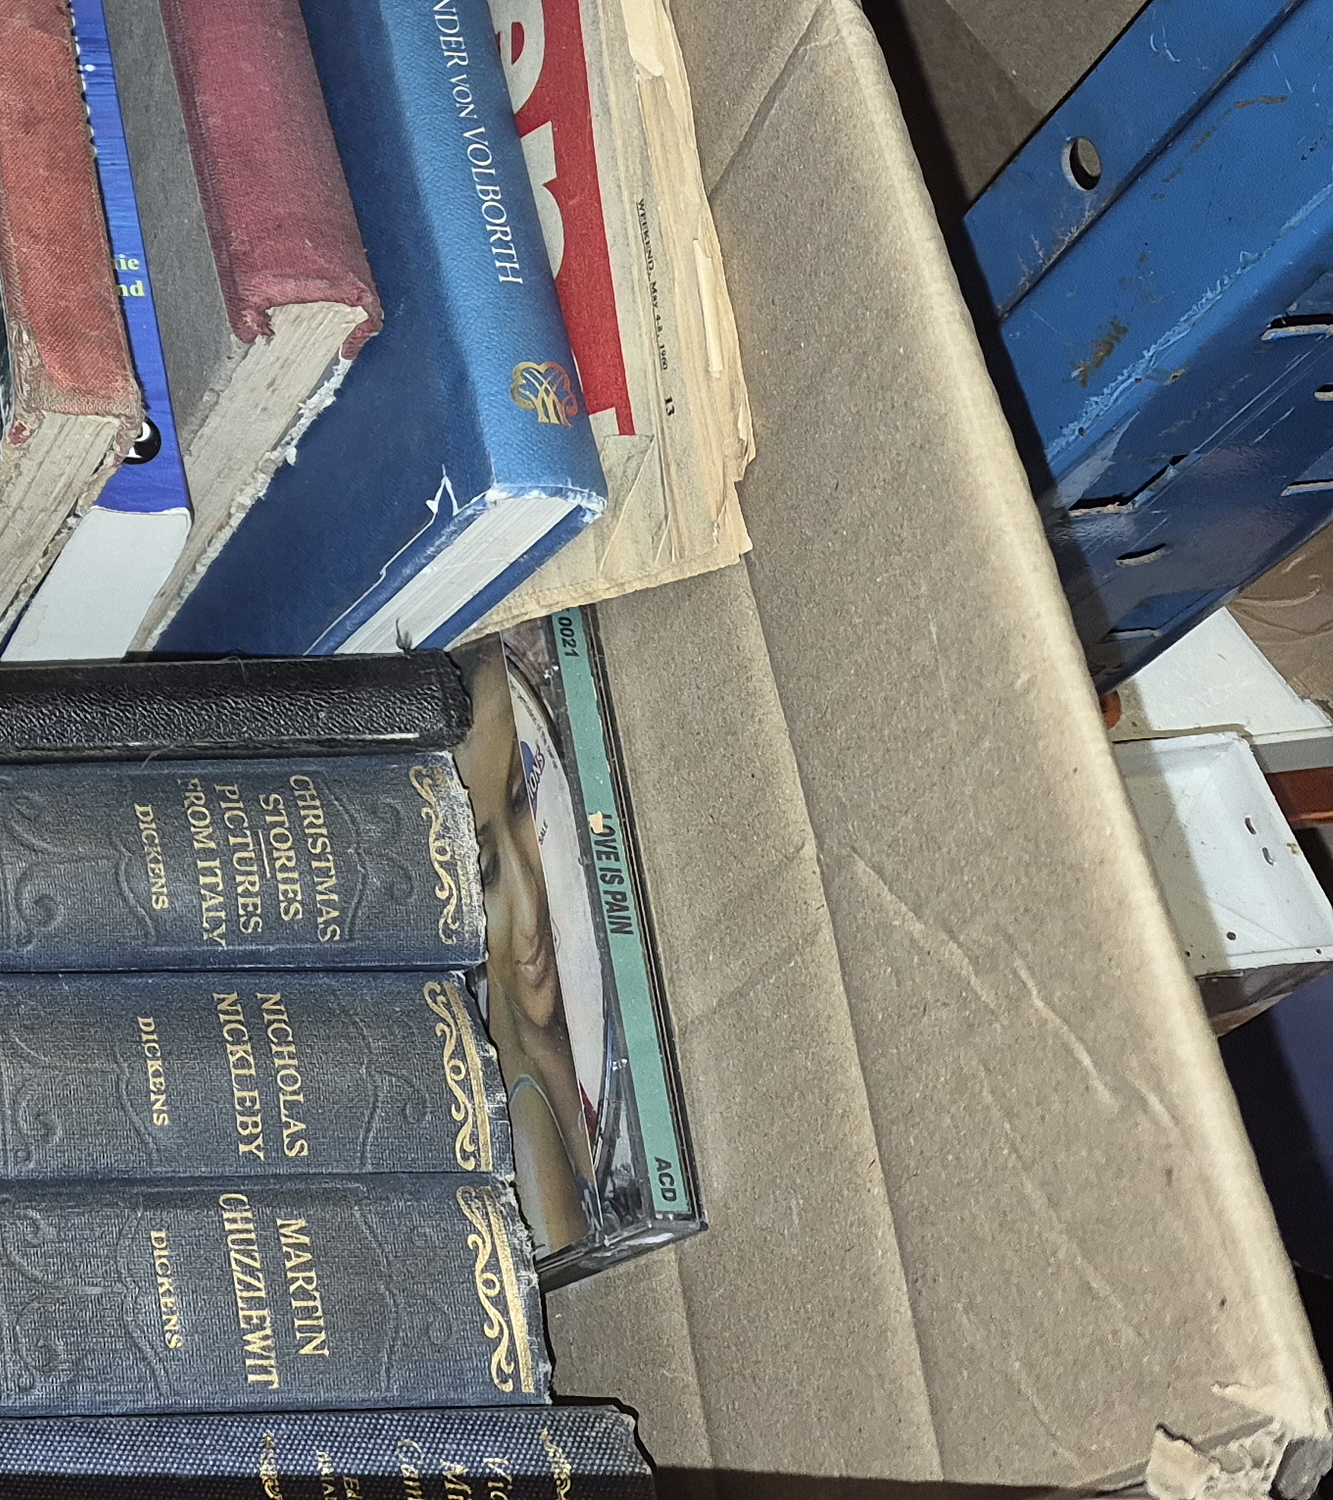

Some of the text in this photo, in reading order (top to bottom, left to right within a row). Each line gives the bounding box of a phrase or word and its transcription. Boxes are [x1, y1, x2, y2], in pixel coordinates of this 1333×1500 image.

[452, 71, 477, 120] VON
[462, 125, 524, 286] VOLBORTH
[649, 280, 659, 310] May
[665, 396, 676, 417] 13
[133, 804, 170, 911] DICKENS
[195, 861, 228, 947] ITALY
[214, 781, 264, 936] PICTURES
[257, 792, 304, 921] STORIES
[288, 772, 340, 943] CHRISTMAS
[599, 869, 624, 887] IS
[604, 887, 636, 937] PAIN
[137, 1015, 170, 1127] DICKENS
[212, 990, 266, 1162] NICKLEBY
[257, 990, 311, 1160] NICHOLAS
[653, 1155, 679, 1205] ACD
[150, 1229, 184, 1351] DICKENS
[217, 1193, 281, 1391] CHUZZLEWIT
[275, 1217, 332, 1360] MARTIN
